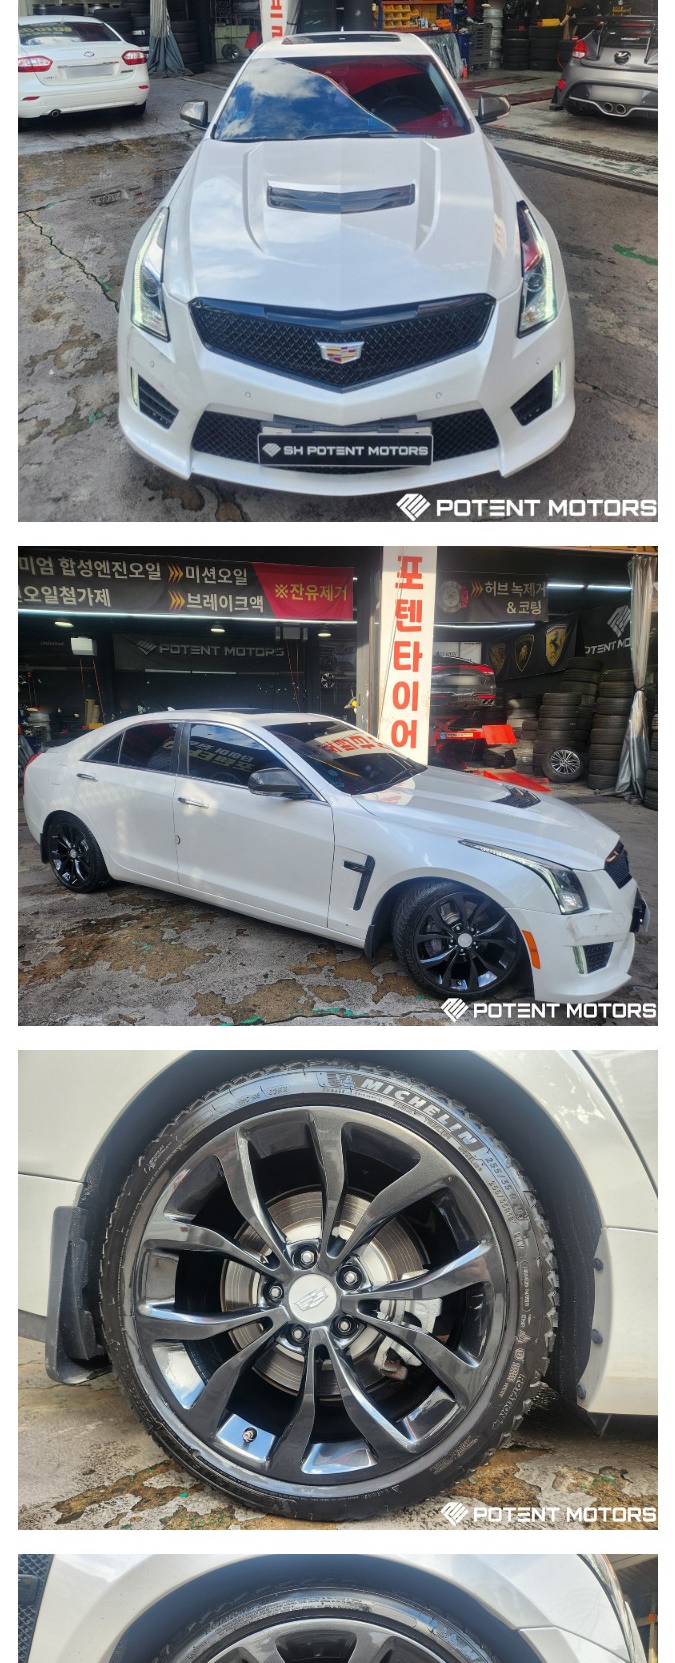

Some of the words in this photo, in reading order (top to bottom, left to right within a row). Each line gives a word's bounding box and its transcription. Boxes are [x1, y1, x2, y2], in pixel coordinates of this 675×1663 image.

[283, 446, 303, 455] SH
[307, 446, 364, 455] POTENT
[368, 446, 428, 456] MOTORS
[57, 557, 162, 581] 합성엔진오일
[185, 564, 249, 587] 미션오일
[484, 581, 510, 597] 허브
[511, 582, 548, 598] 녹제거
[186, 592, 265, 613] 브레이크액
[506, 602, 517, 614] &
[518, 601, 543, 615] 코팅
[158, 643, 221, 657] POTENT
[224, 646, 286, 658] MOTORS
[390, 556, 424, 750] 포텐타이어
[361, 1078, 479, 1147] MICHELIN
